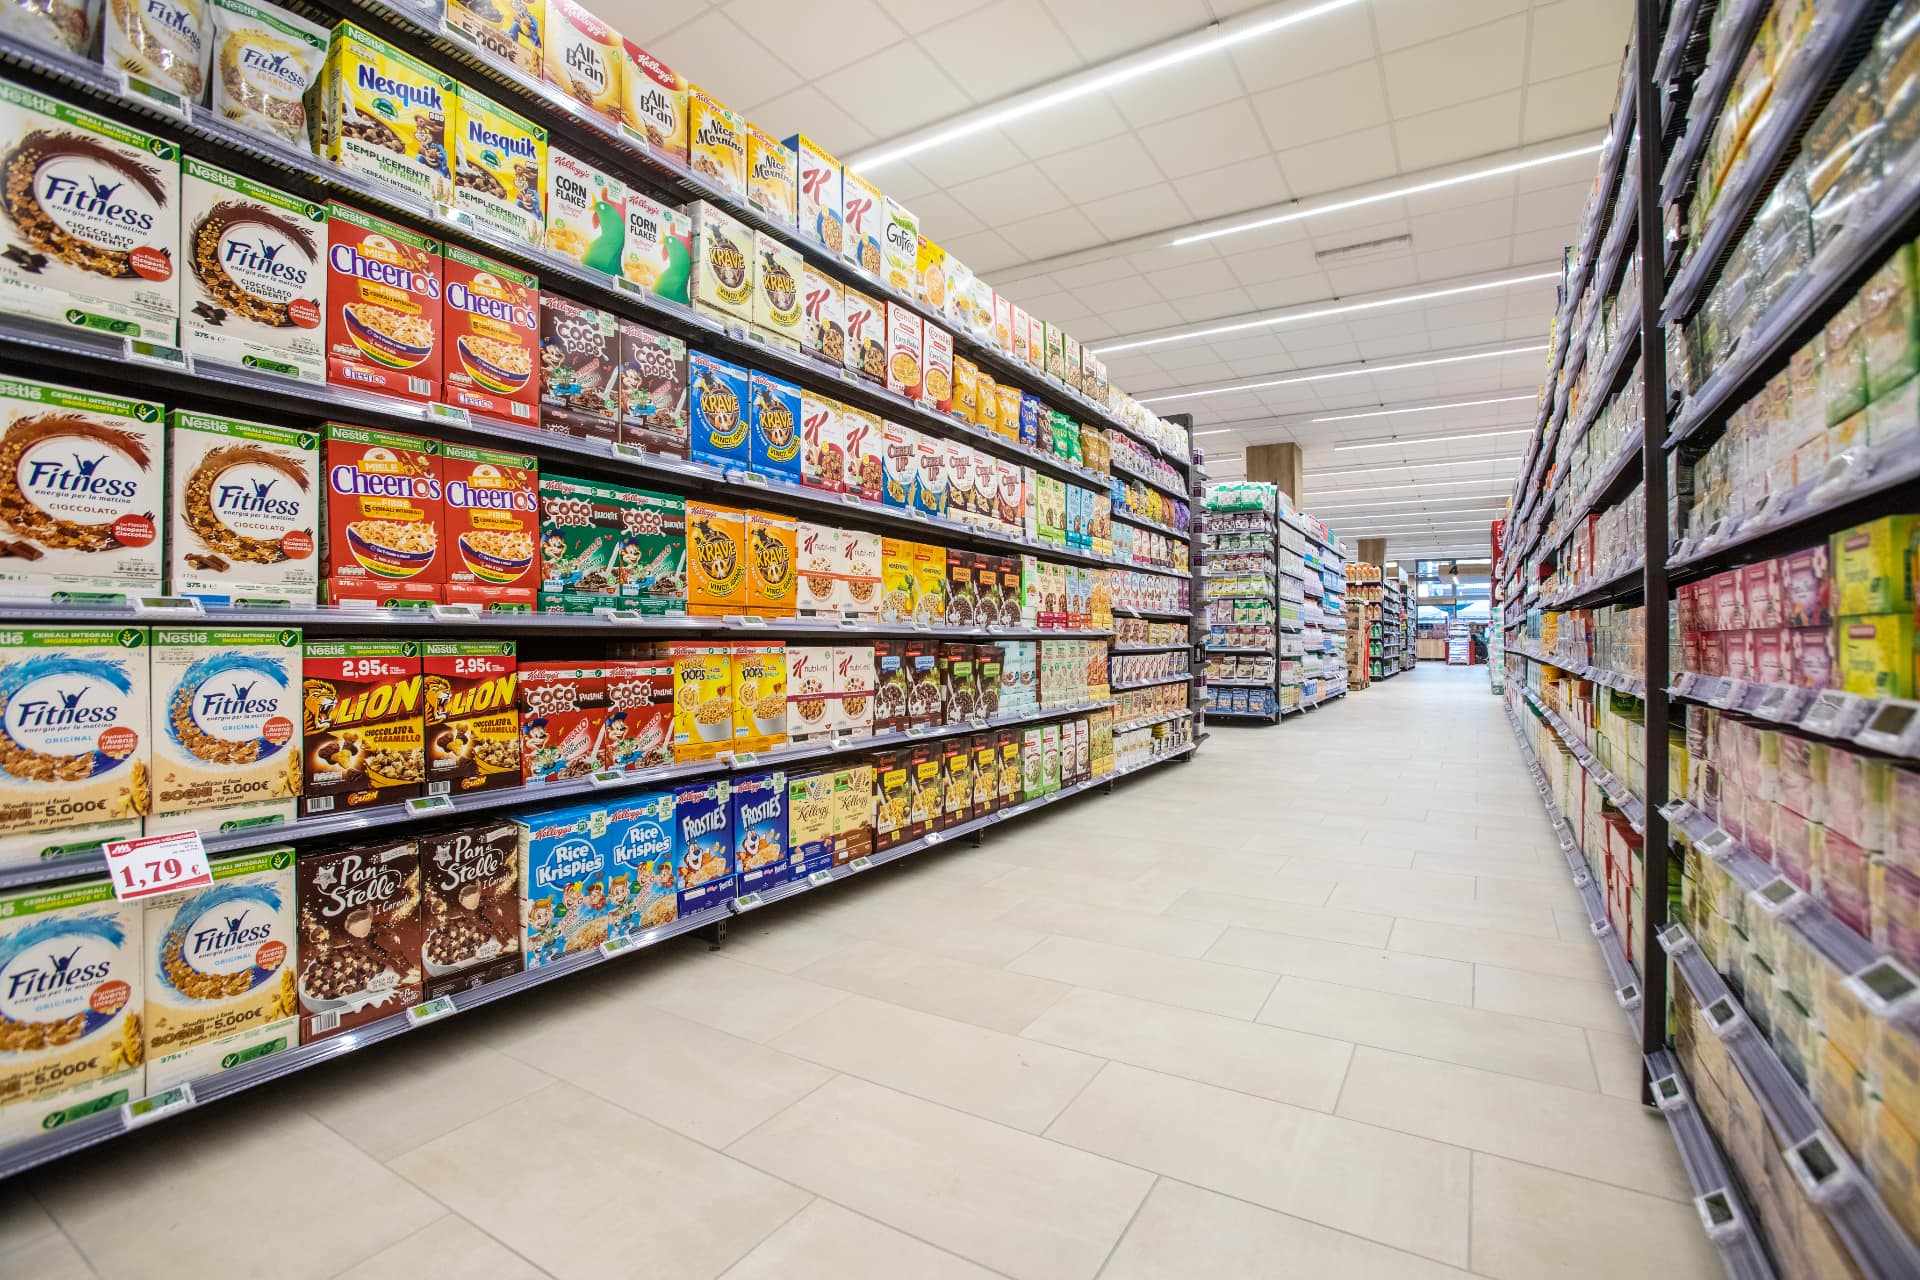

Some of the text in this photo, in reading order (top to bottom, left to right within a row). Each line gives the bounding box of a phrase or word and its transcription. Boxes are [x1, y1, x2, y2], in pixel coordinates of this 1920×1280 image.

[147, 2, 201, 50] Fitness
[564, 1, 608, 37] Kellogg's
[349, 27, 386, 52] Nestlé
[576, 42, 601, 65] All-
[243, 48, 305, 88] Fitness
[566, 48, 604, 86] Bran
[637, 52, 676, 84] Kellogg's
[358, 64, 443, 111] Nesquik
[461, 87, 490, 109] Nestlé
[696, 92, 721, 112] Kellogg's
[640, 94, 673, 126] Bran
[711, 119, 735, 138] Nice
[469, 121, 537, 159] Nesquik
[696, 128, 744, 155] Morning
[346, 141, 430, 182] SEMPLICEMENTE
[554, 156, 590, 179] Kellogg's
[764, 154, 786, 170] Nice
[188, 162, 236, 188] Nestlé
[362, 168, 422, 197] CEREALI INTEGRALI
[379, 162, 432, 189] NUTRIENTI
[556, 176, 587, 199] CORN
[803, 169, 832, 206] K
[45, 174, 154, 230] Fitness
[459, 191, 527, 225] SEMPLICEMENTE
[555, 191, 586, 209] FLAKES
[629, 195, 660, 215] Kellogg's
[88, 215, 102, 223] per
[332, 206, 369, 226] Nestlé
[486, 207, 529, 231] NUTRIENTI
[630, 213, 657, 233] CORN
[845, 199, 872, 234] K
[66, 220, 134, 245] CIOCCOLATO
[72, 228, 129, 250] FONDENTE
[630, 225, 656, 243] FLAKES
[225, 239, 307, 284] Fitness
[365, 248, 398, 263] MIELE
[448, 248, 478, 266] Nestlé
[709, 247, 746, 269] KRAVE
[330, 245, 440, 299] Cheerios
[241, 279, 292, 297] CIOCCOLATO
[246, 286, 288, 301] FONDENTE
[764, 275, 796, 293] KRAVE
[447, 283, 537, 329] Cheerios
[546, 298, 582, 317] Kellogg's
[805, 289, 831, 321] K
[558, 323, 604, 347] COCO
[626, 325, 657, 343] Kellogg's
[848, 310, 872, 341] K
[636, 349, 675, 370] COCO
[694, 356, 720, 373] Kellogg's
[755, 375, 778, 389] Kellogg's
[51, 391, 129, 409] CEREALI INTEGRALI
[701, 394, 739, 413] KRAVE
[181, 415, 228, 432] Nestlé
[759, 410, 793, 429] KRAVE
[804, 411, 829, 447] K
[332, 428, 369, 442] Nestlé
[847, 425, 869, 459] K
[446, 447, 478, 459] Nestlé
[888, 444, 915, 458] CEREAL
[366, 463, 399, 473] MIELE
[896, 456, 909, 472] UP
[921, 455, 945, 468] CEREAL
[28, 460, 137, 497] Fitness
[331, 465, 441, 499] Cheerios
[474, 478, 502, 487] MIELE
[929, 466, 940, 481] UP
[446, 481, 537, 511] Cheerios
[545, 480, 576, 495] Kellogg's
[49, 503, 118, 515] CIOCCOLATO
[218, 485, 300, 516] Fitness
[365, 505, 371, 513] 5
[547, 501, 591, 517] COCO
[623, 494, 649, 505] Kellogg's
[624, 512, 662, 526] COCO
[690, 505, 718, 519] Kellogg's
[751, 514, 774, 527] Kellogg's
[234, 521, 285, 532] CIOCCOLATO
[697, 539, 737, 564] KRAVE
[756, 547, 788, 568] KRAVE
[158, 632, 208, 643] Nestlé
[307, 645, 346, 656] Nestlé
[427, 644, 457, 654] Nestlé
[673, 646, 697, 657] Kellogg's
[342, 659, 389, 679] 2,95€
[455, 658, 492, 675] 2,95€
[528, 669, 559, 682] Kellogg's
[609, 668, 637, 679] Kellogg's
[681, 669, 705, 684] POPS
[743, 666, 764, 681] POPS
[334, 675, 422, 724] LION
[450, 673, 517, 717] LION
[529, 687, 575, 706] COCO
[610, 684, 651, 700] COCO
[18, 701, 118, 727] Fitness
[202, 693, 278, 716] Fitness
[364, 726, 415, 737] CIOCCOLATO &
[473, 719, 506, 729] CIOCCOLATO
[480, 725, 517, 734] CARAMELLO
[44, 736, 93, 744] ORIGINAL
[373, 735, 421, 743] CARAMELLO
[160, 780, 270, 801] SOGNI 5.000€
[678, 791, 705, 803] Kellogg's
[737, 782, 762, 793] Kellogg's
[45, 799, 107, 818] 5.000€
[611, 808, 644, 822] Kellogg's
[740, 795, 782, 827] FROSTIES
[682, 804, 727, 838] FROSTIES
[535, 825, 573, 841] Kellogg's
[630, 827, 658, 843] Rice
[455, 835, 485, 863] Pan
[555, 844, 589, 863] Rice
[615, 837, 672, 863] Krispies
[120, 858, 201, 888] 1,79 €
[234, 859, 268, 869] INTEGRALI
[341, 855, 388, 885] Pan di
[441, 854, 499, 891] Stelle
[538, 856, 603, 887] Krispies
[322, 875, 395, 917] Stelle
[193, 923, 271, 955] Fitness
[214, 954, 251, 966] ORIGINAL
[8, 961, 110, 999] Fitness
[152, 1007, 264, 1048] SOGNI 5.000€
[34, 1057, 99, 1085] 5.000€
